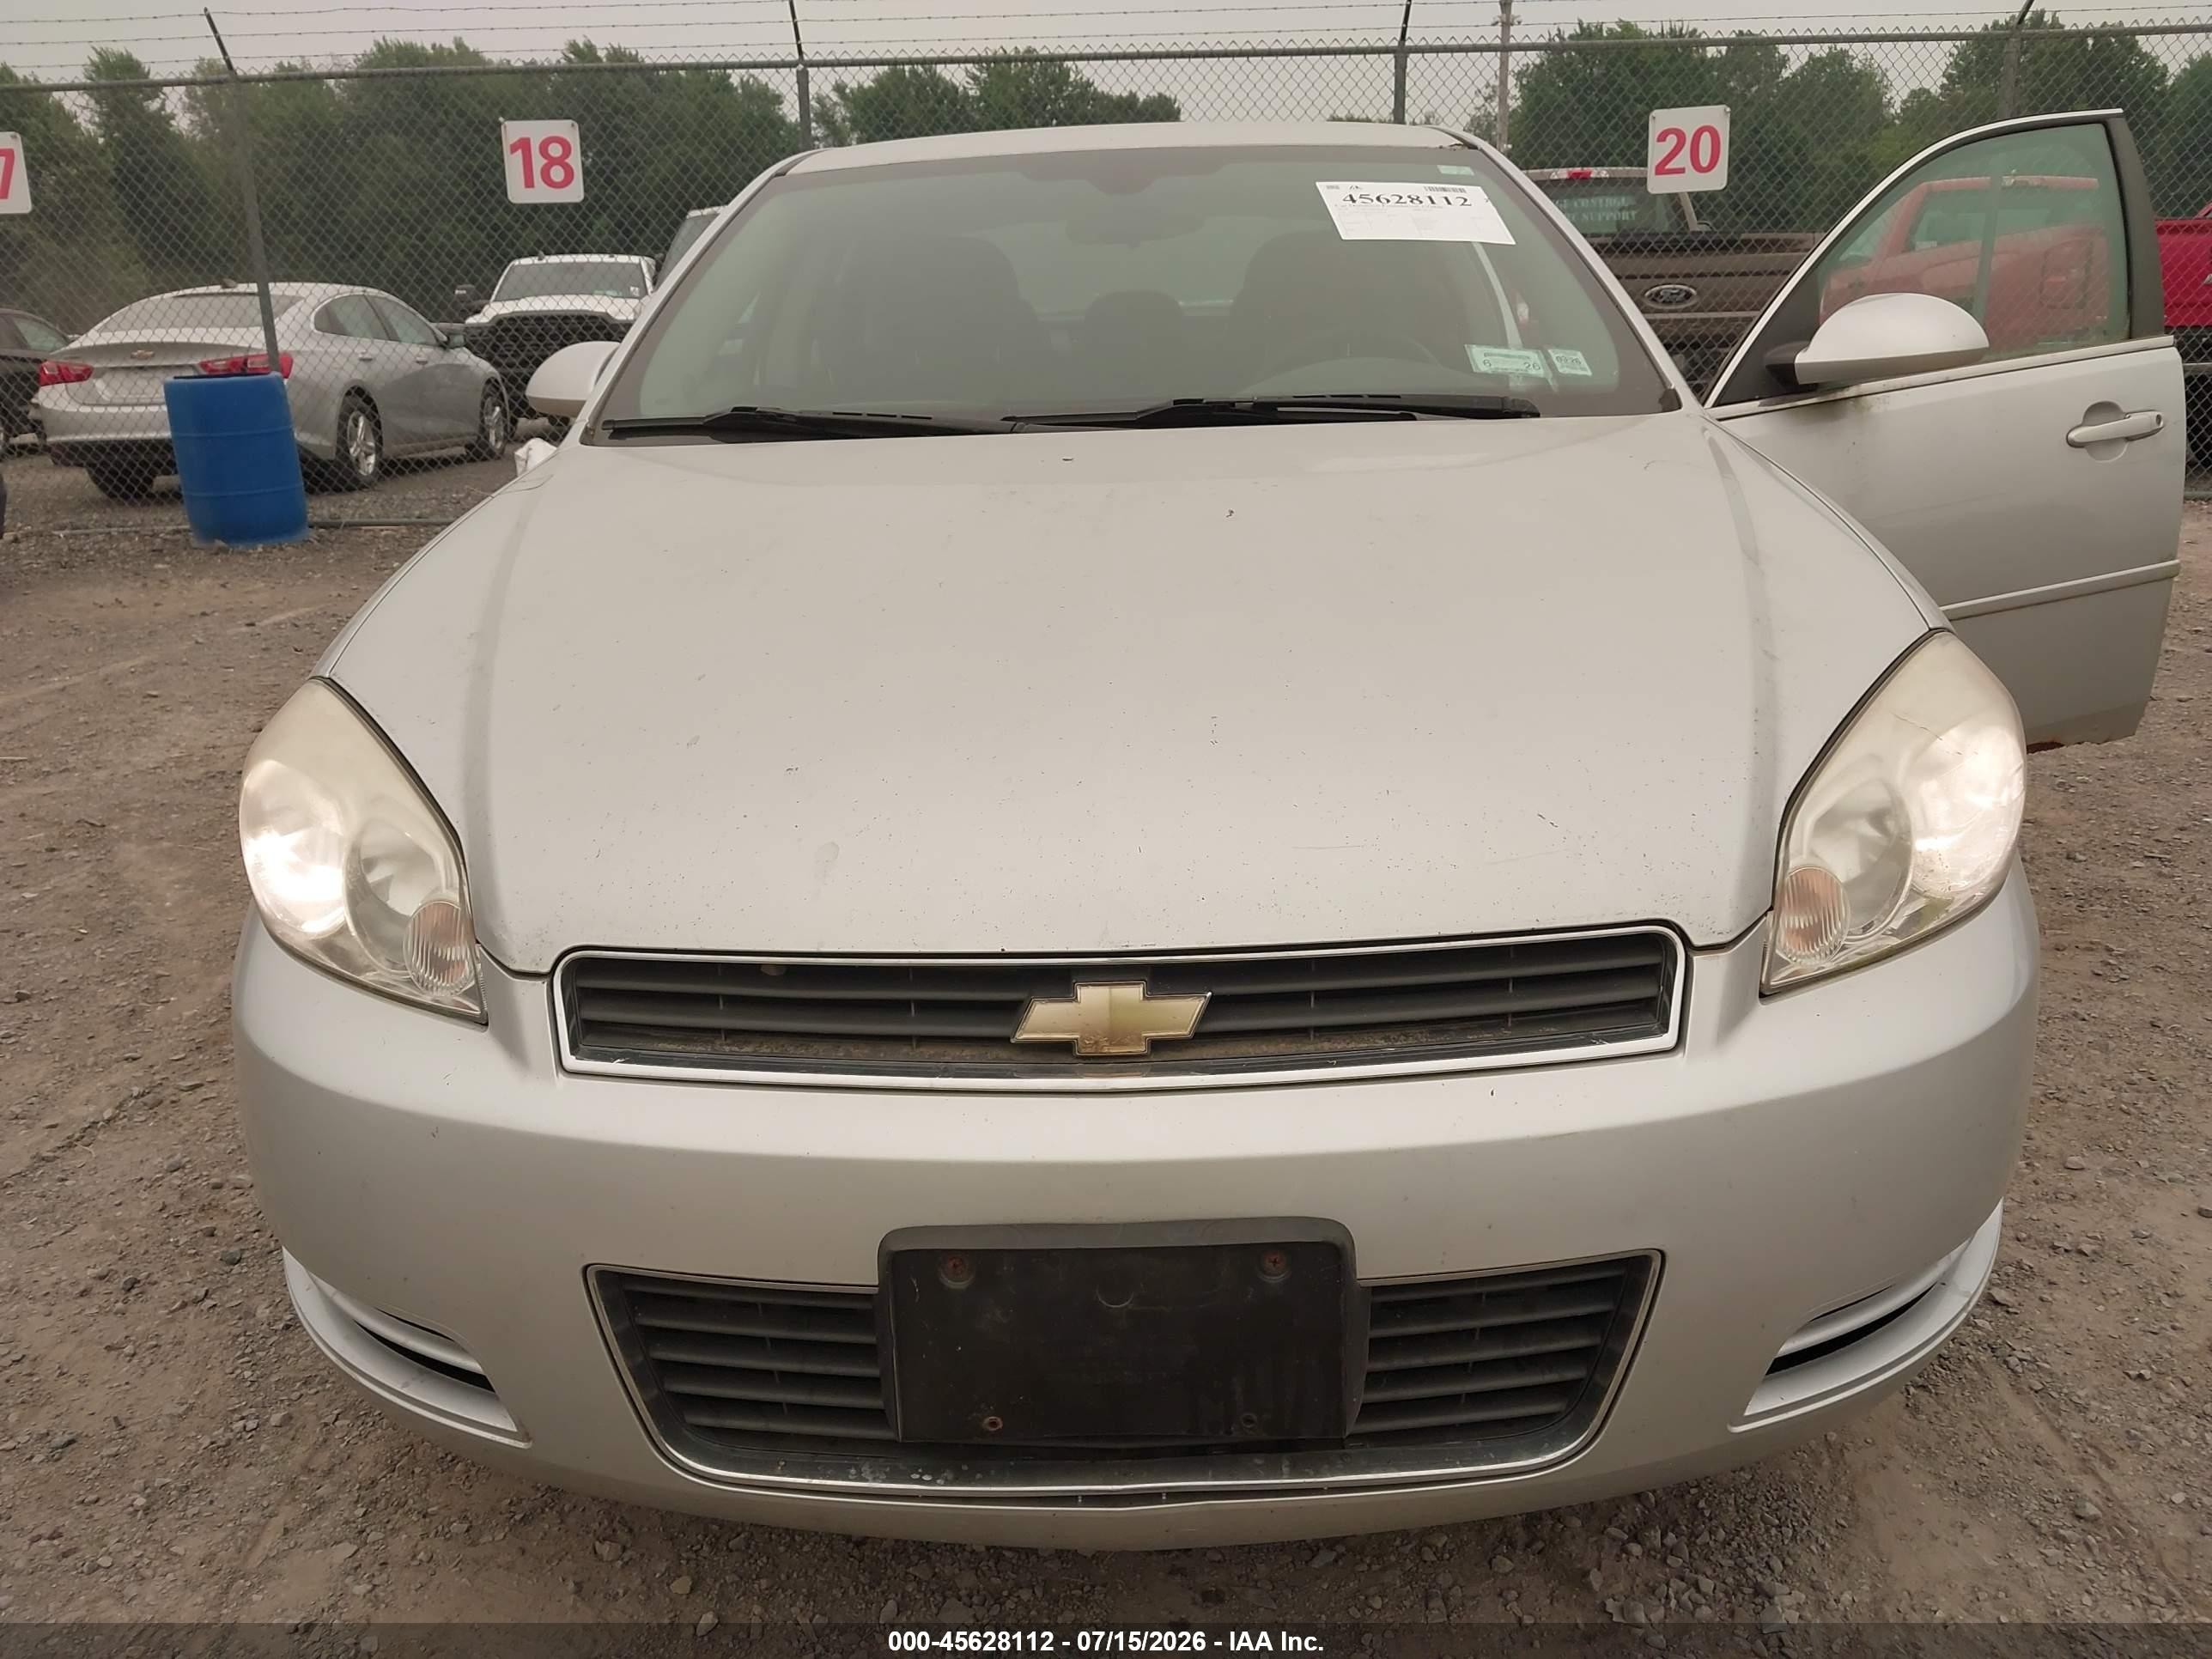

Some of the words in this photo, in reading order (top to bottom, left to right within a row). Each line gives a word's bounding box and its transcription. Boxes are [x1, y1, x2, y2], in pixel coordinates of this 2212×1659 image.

[509, 136, 574, 190] 18
[1655, 125, 1721, 176] 20
[1342, 192, 1473, 207] 45628112
